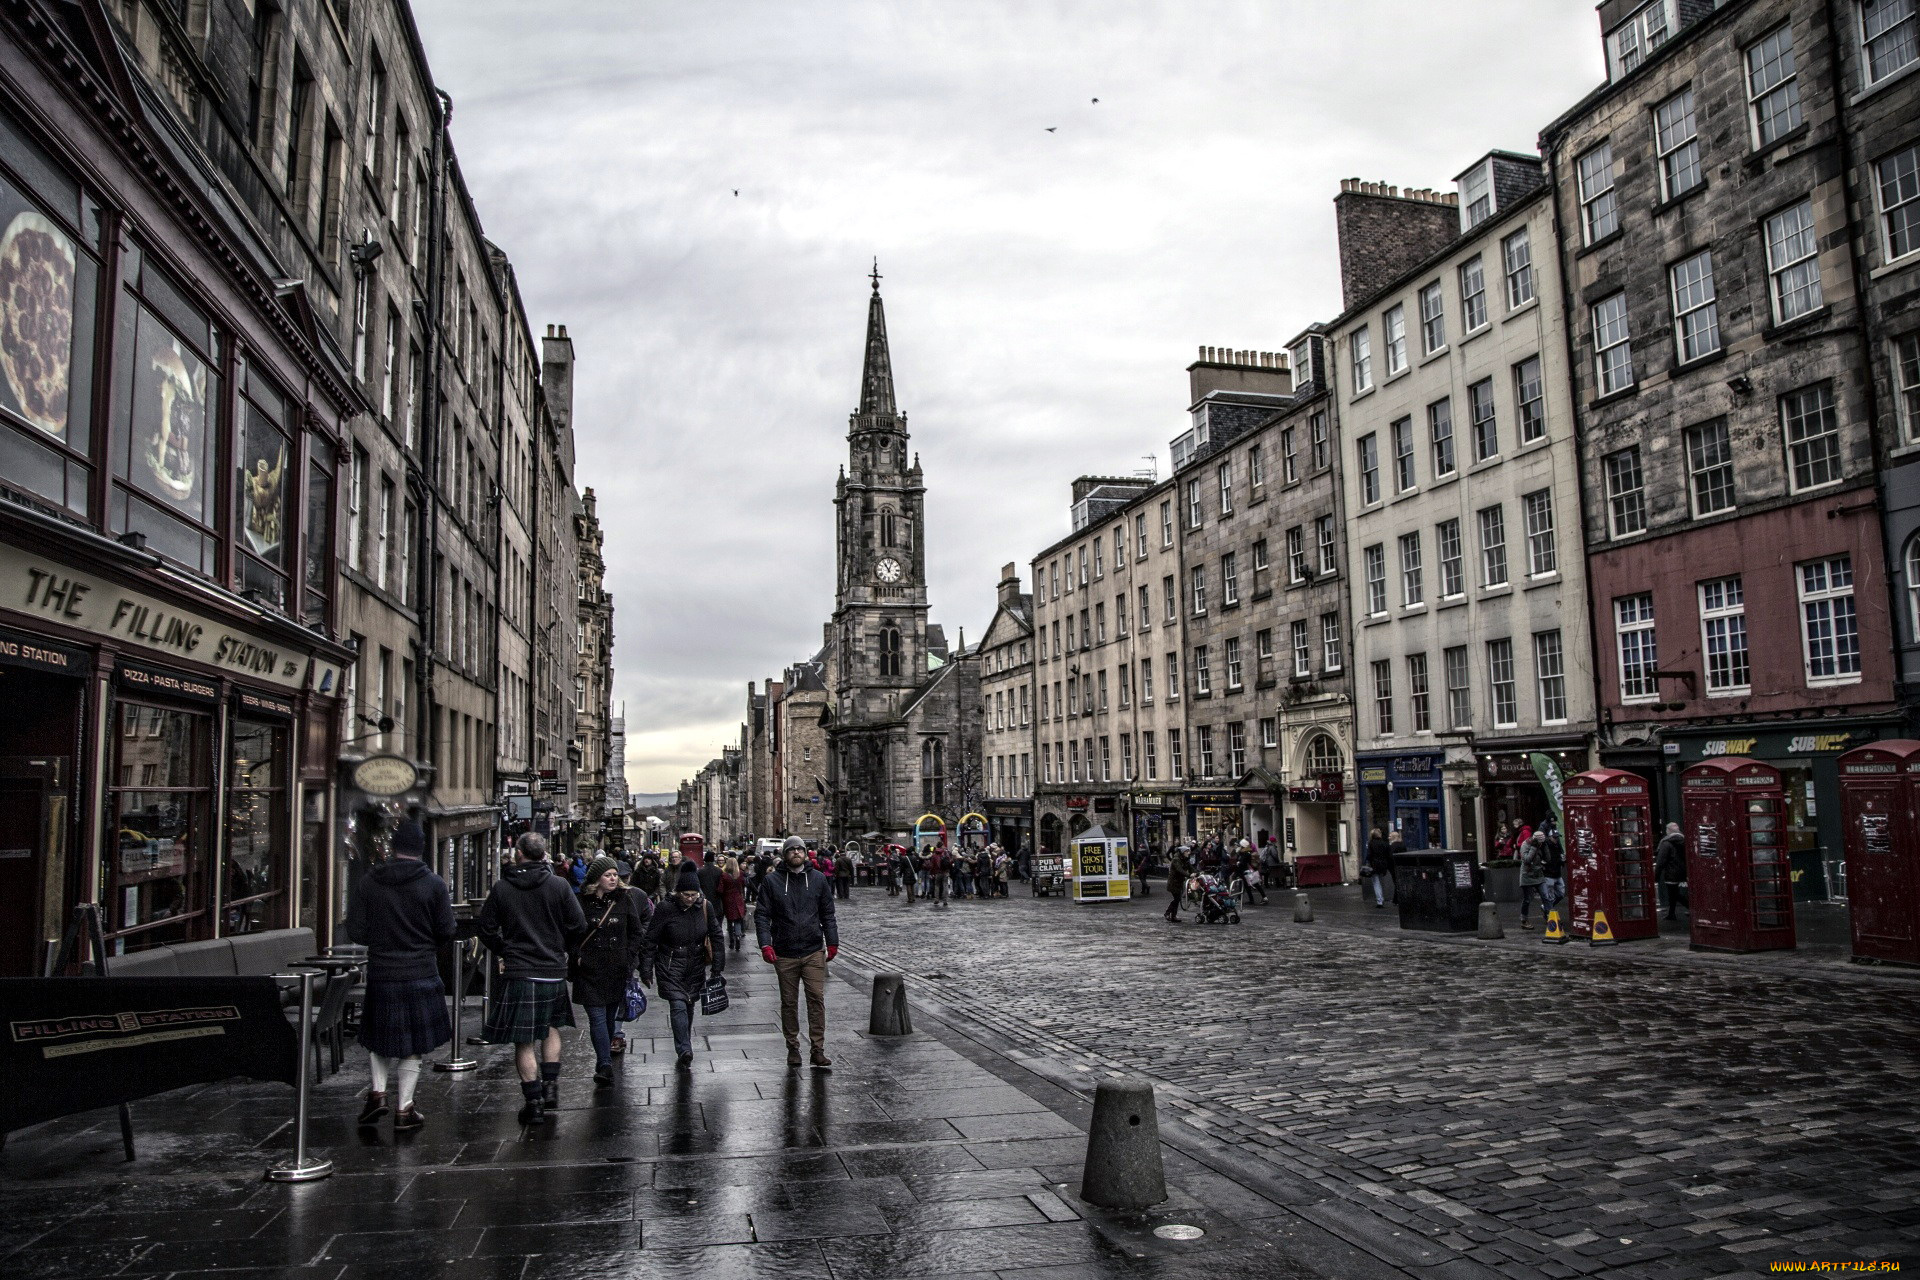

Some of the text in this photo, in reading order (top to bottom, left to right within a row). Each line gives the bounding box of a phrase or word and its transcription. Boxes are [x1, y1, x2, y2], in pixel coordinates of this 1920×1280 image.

[28, 567, 91, 618] THE
[110, 598, 203, 652] FILLING
[214, 634, 278, 674] STATION
[22, 645, 67, 666] STATION
[124, 668, 215, 698] PIZZA PASTA BURGERS
[242, 695, 259, 706] BEERS
[1702, 738, 1757, 756] SUBWAY
[1787, 732, 1850, 753] SUBWAY
[1848, 764, 1895, 774] TELEPHONE
[1607, 786, 1642, 794] TELEPHONE
[1084, 846, 1102, 855] FREE
[1039, 858, 1054, 866] PUB
[1082, 855, 1105, 864] GHOST
[1084, 865, 1105, 874] TOUR
[1053, 876, 1064, 885] £7
[18, 1018, 115, 1037] FILLING
[140, 1009, 234, 1024] STATION
[85, 1039, 109, 1050] Coast
